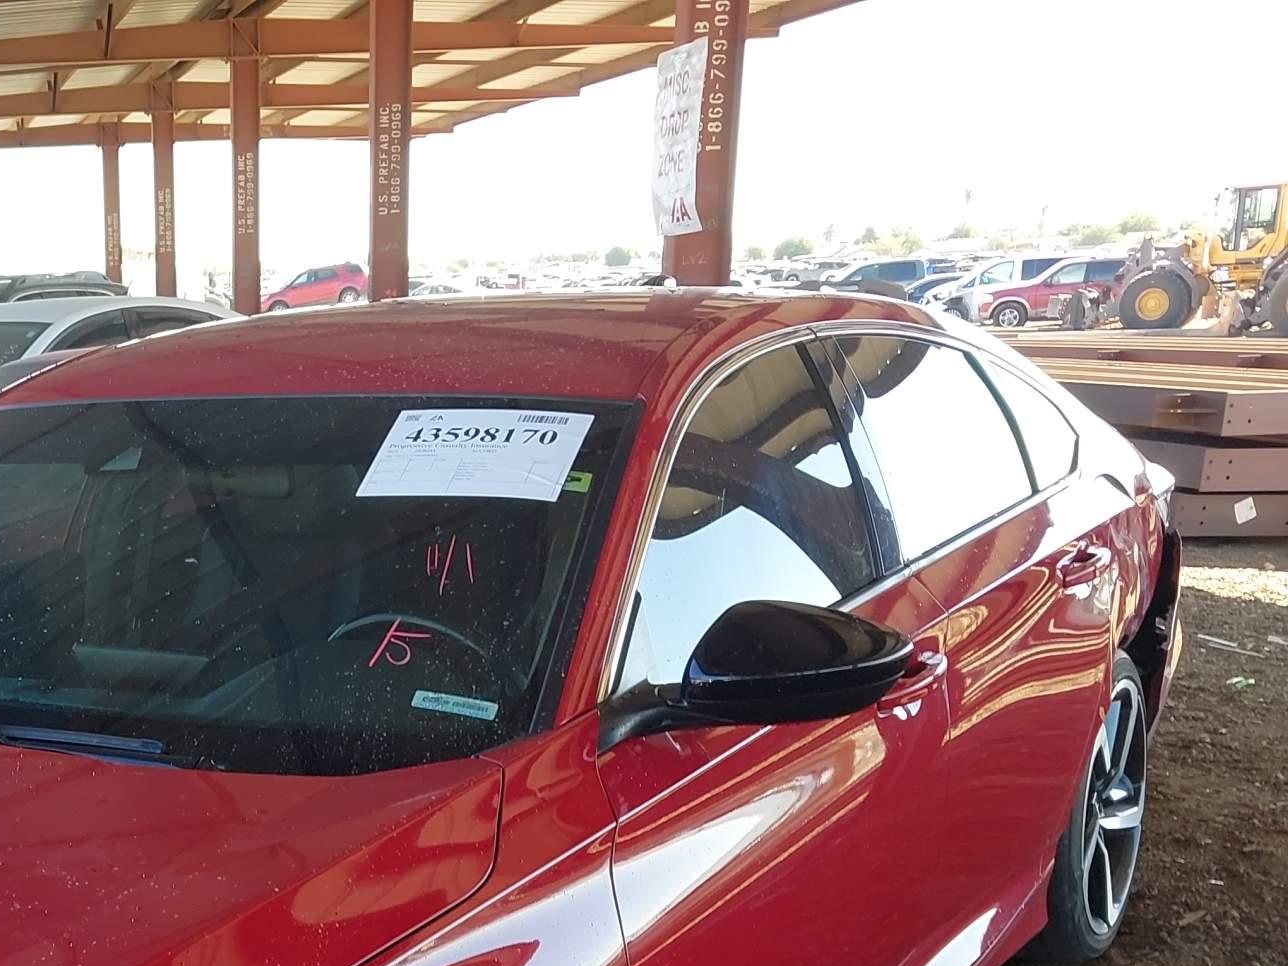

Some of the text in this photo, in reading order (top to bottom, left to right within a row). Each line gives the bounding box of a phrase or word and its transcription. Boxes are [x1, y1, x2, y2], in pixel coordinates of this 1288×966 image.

[663, 70, 691, 99] MISC.
[660, 111, 689, 138] DROP
[378, 102, 390, 216] U.S. PREFAB INC.
[391, 103, 402, 214] 1-866-799-0969
[658, 151, 684, 177] ZONE
[405, 427, 558, 445] 43598170
